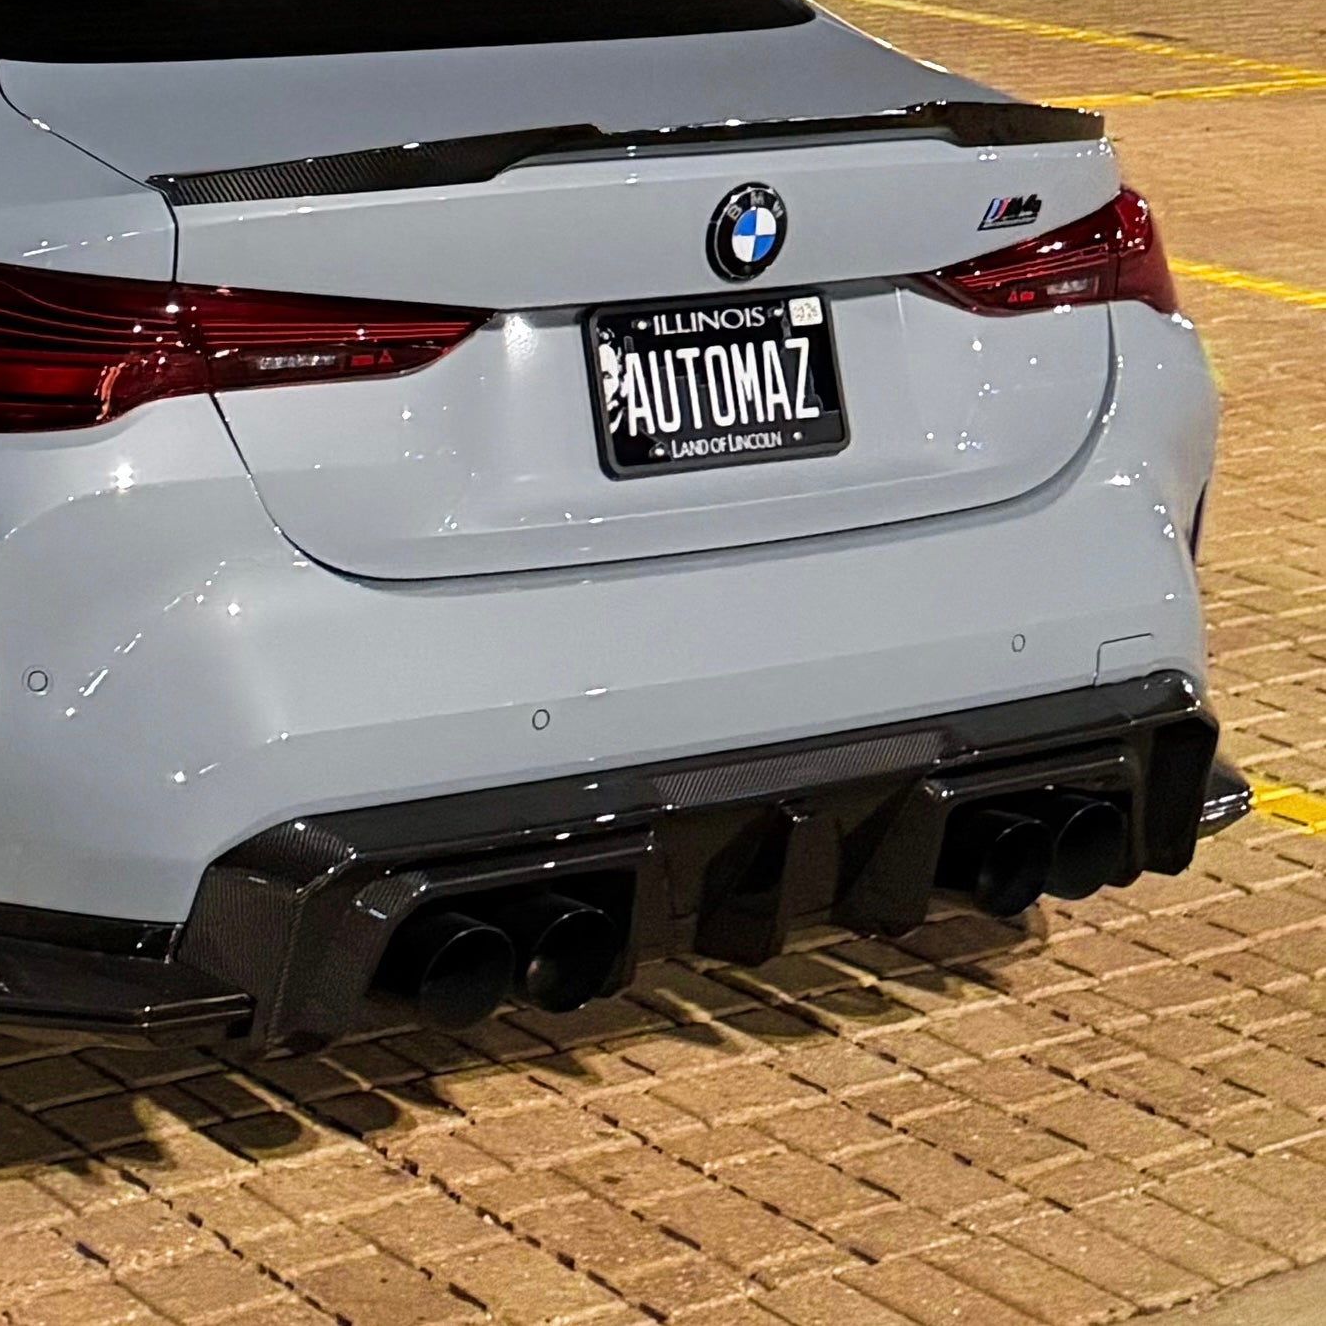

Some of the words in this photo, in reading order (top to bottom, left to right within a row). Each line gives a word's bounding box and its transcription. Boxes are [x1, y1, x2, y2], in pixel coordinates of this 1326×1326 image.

[727, 190, 784, 221] BMW
[653, 306, 766, 336] ILLINOIS
[624, 336, 820, 437] AUTOMAZ
[670, 439, 709, 459] LAND
[710, 436, 727, 454] OF
[727, 431, 783, 452] LINCOLN
